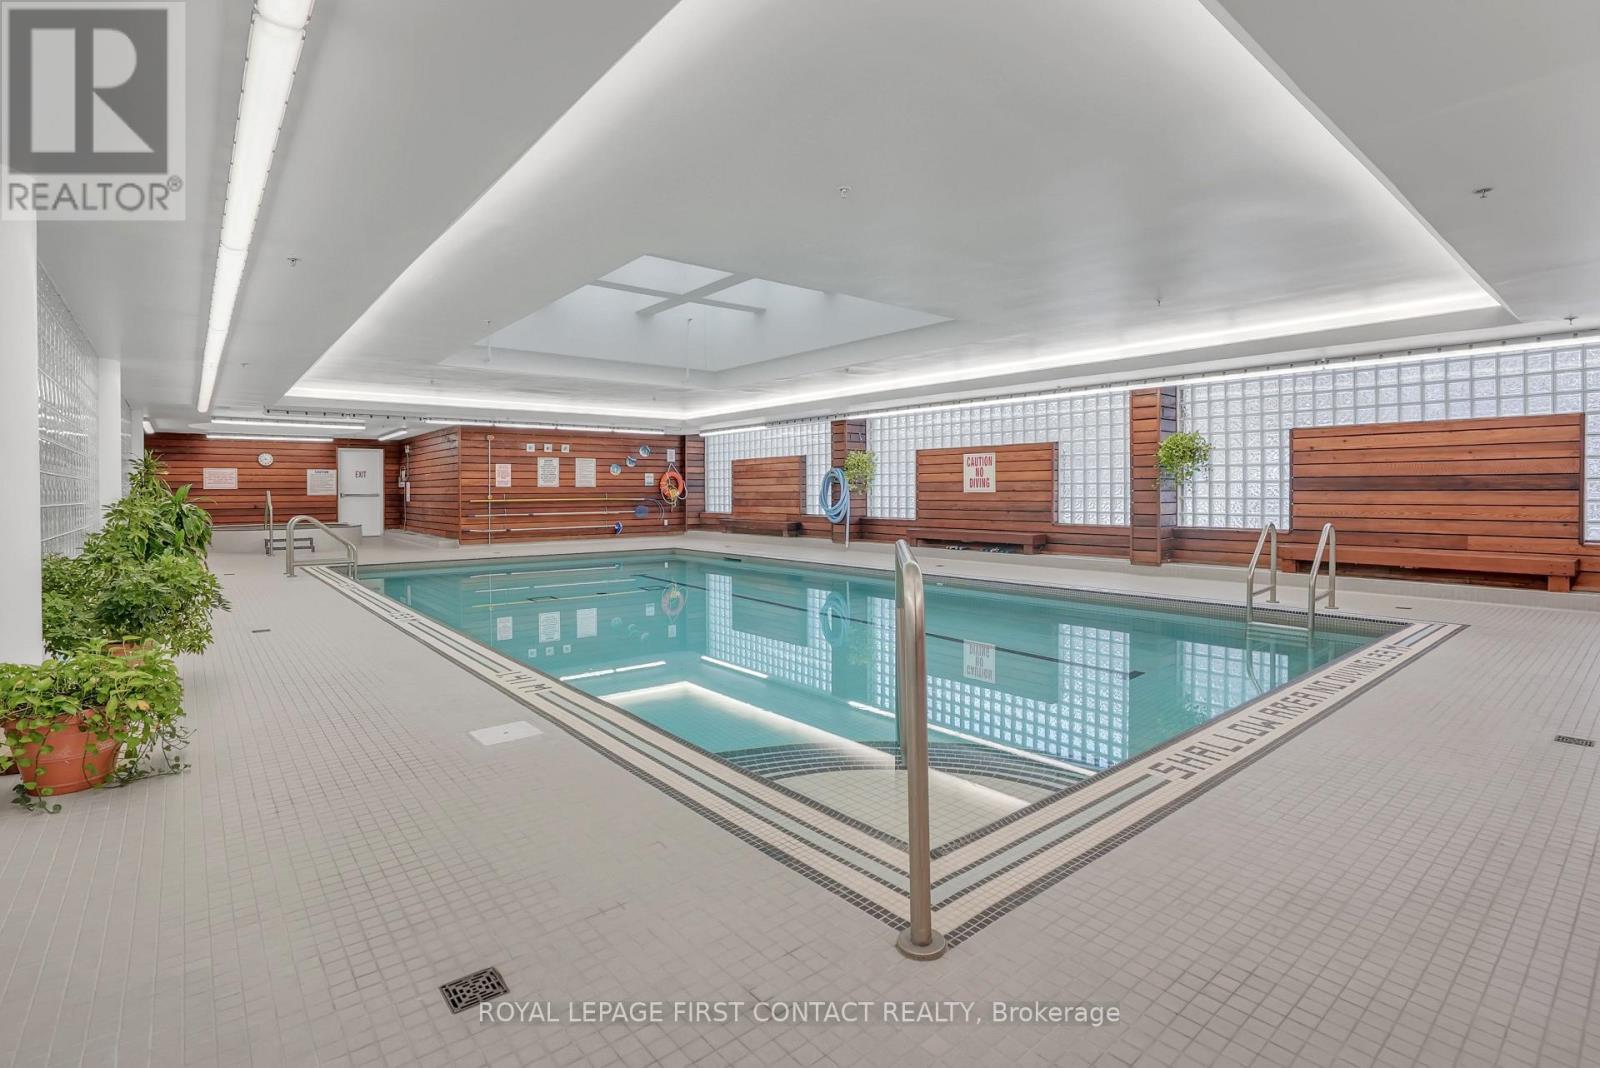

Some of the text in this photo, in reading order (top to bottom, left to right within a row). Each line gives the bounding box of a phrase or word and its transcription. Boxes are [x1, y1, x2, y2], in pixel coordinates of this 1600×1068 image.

[967, 456, 993, 467] CAUTION
[355, 470, 367, 479] EXIT
[975, 467, 984, 477] NO
[969, 478, 990, 489] DIVING
[1323, 659, 1385, 683] DIVING
[1302, 680, 1347, 695] NO
[1258, 691, 1328, 719] AREA
[1148, 715, 1285, 780] SHALLOW
